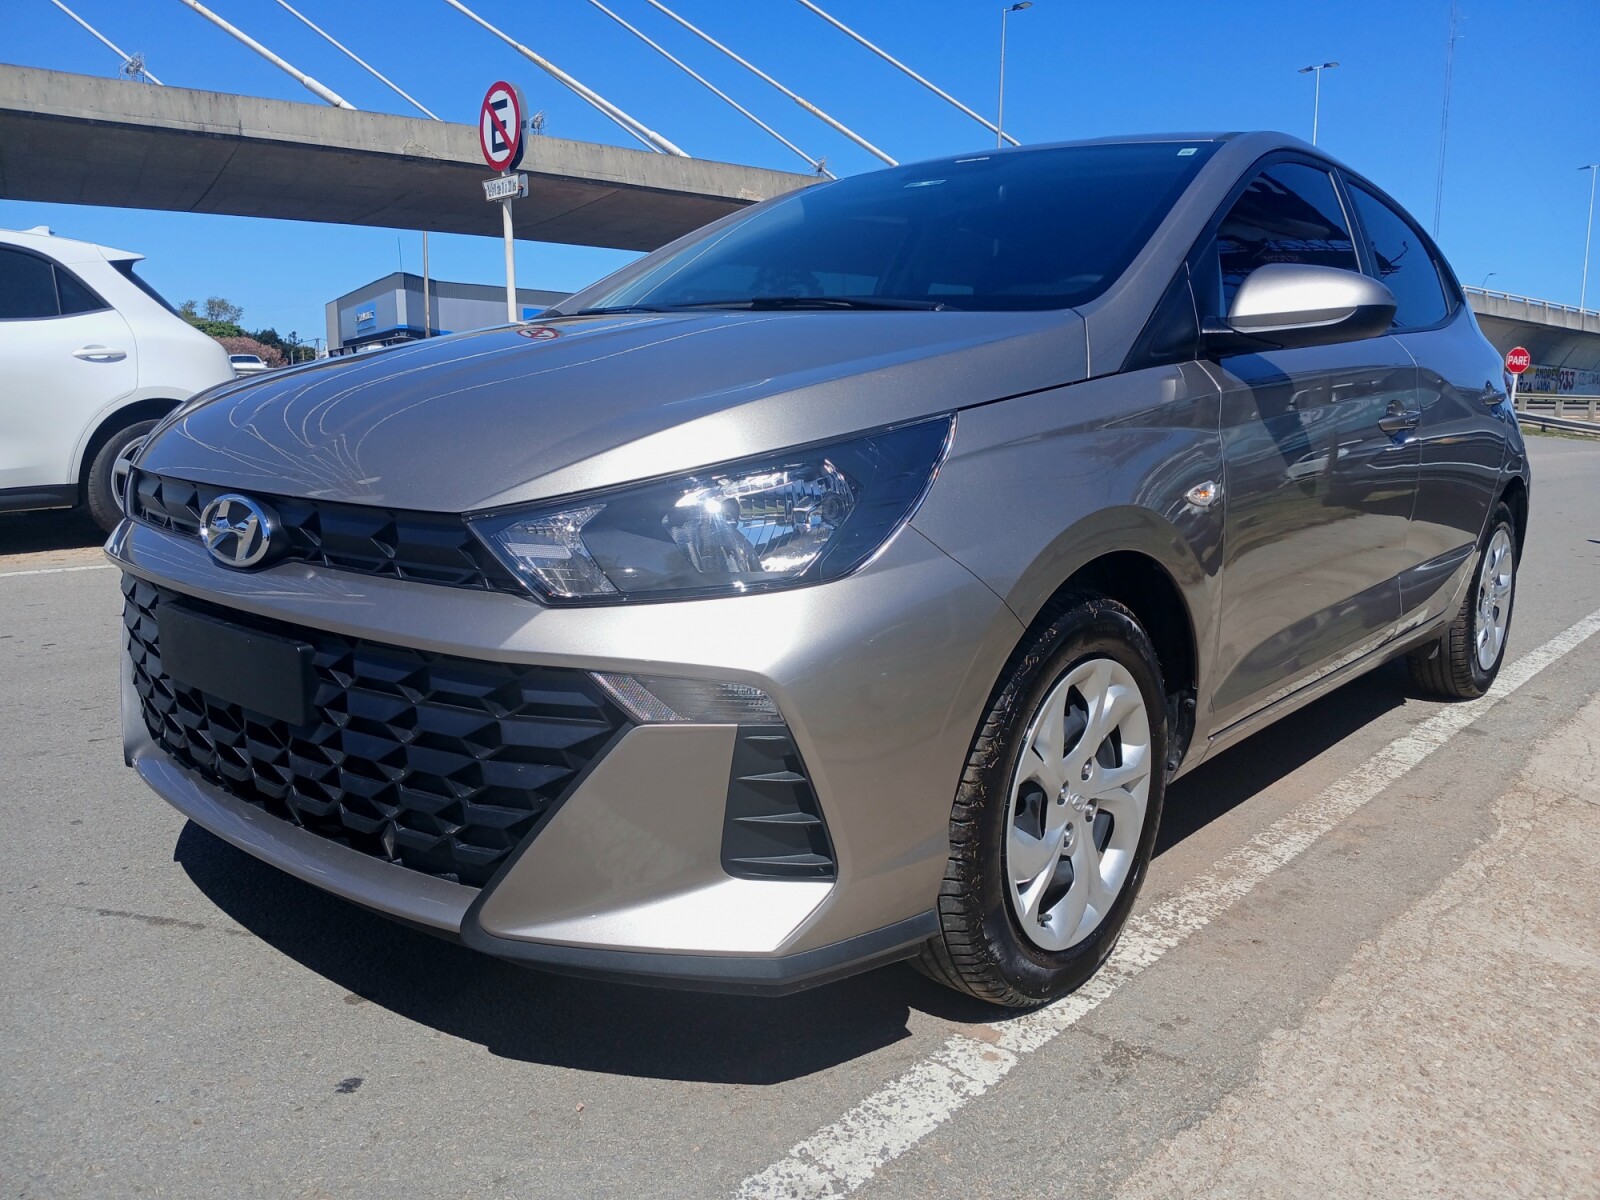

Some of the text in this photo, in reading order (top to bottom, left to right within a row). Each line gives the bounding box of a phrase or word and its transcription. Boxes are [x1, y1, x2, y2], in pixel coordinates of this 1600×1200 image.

[491, 98, 509, 154] E
[1507, 355, 1528, 365] PARE
[1559, 370, 1576, 390] 933
